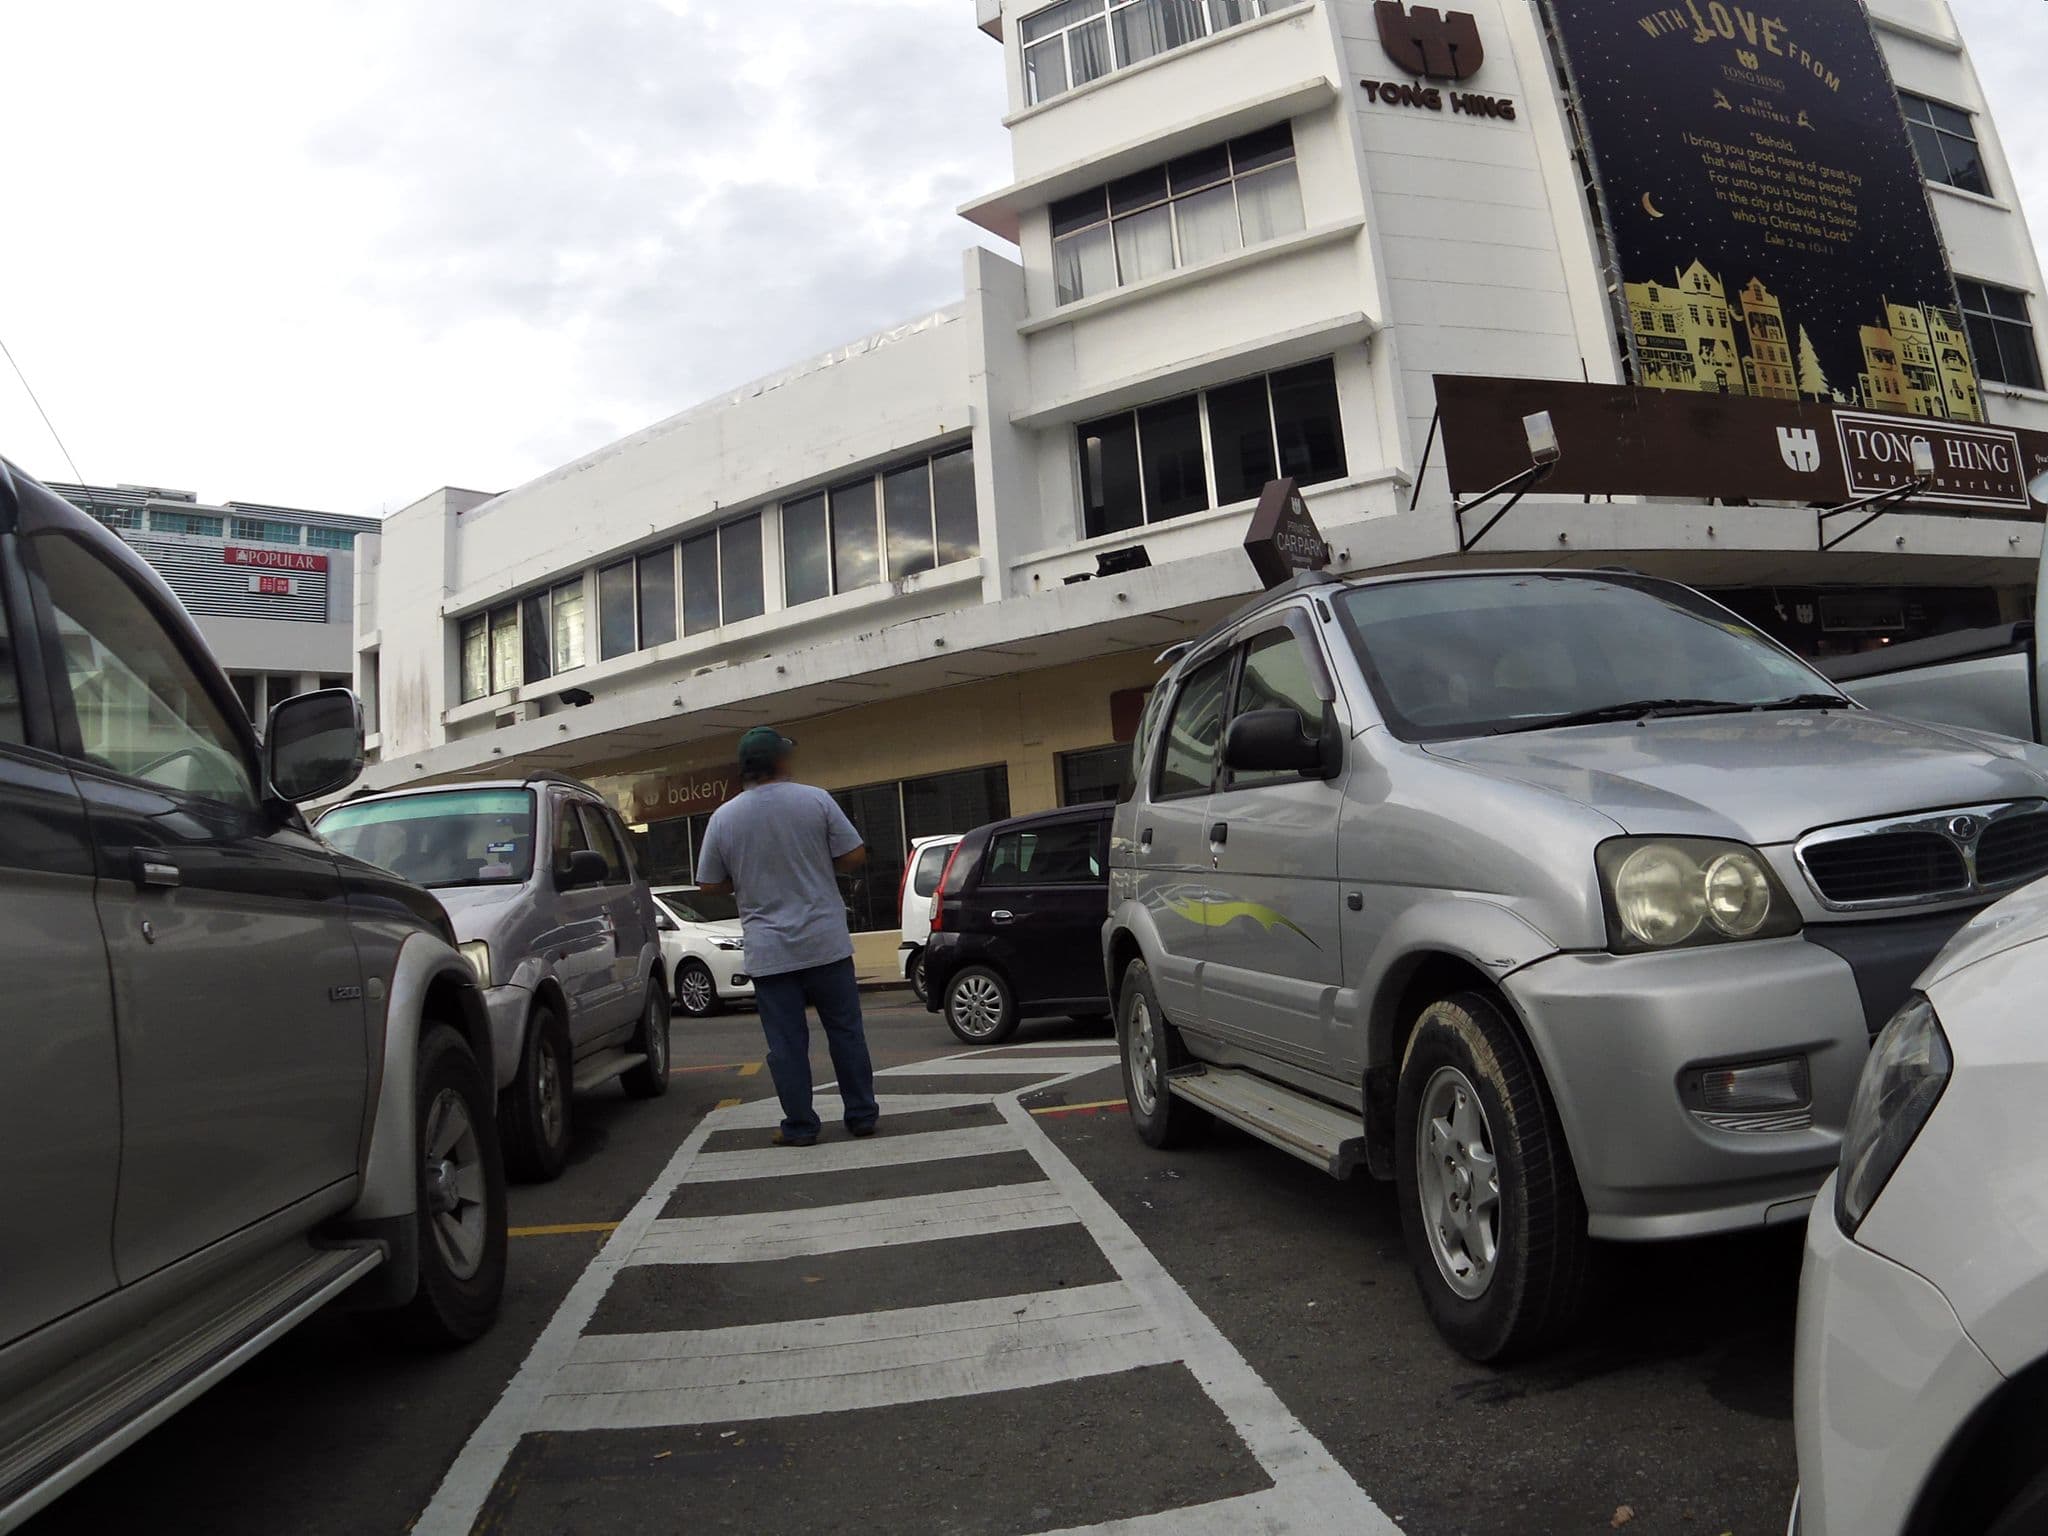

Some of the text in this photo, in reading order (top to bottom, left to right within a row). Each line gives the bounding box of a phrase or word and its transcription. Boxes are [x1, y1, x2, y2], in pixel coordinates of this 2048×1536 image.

[1637, 0, 1841, 93] WITH LOVE FROM
[1360, 80, 1516, 121] TONG HING
[1689, 132, 1721, 153] bring
[1723, 143, 1744, 156] you
[1746, 148, 1776, 163] good
[1778, 155, 1805, 170] news
[1806, 161, 1817, 173] of
[1819, 166, 1847, 181] great
[1847, 172, 1863, 187] joy
[1702, 152, 1726, 168] that
[1728, 158, 1748, 172] will
[1749, 163, 1765, 177] be
[1766, 165, 1782, 180] for
[1784, 170, 1797, 184] all
[1799, 174, 1816, 188] the
[1708, 169, 1729, 185] For
[1732, 177, 1758, 191] unto
[1759, 182, 1780, 196] you
[1782, 185, 1792, 198] is
[1819, 194, 1839, 209] this
[1839, 200, 1858, 216] day
[1714, 187, 1728, 201] in
[1728, 190, 1749, 206] the
[1751, 195, 1771, 213] city
[1773, 199, 1785, 213] of
[1785, 201, 1817, 221] David
[1731, 209, 1757, 225] who
[1758, 212, 1769, 226] is
[1769, 214, 1803, 233] Christ
[1804, 222, 1822, 237] the
[1848, 428, 2010, 474] TON HING
[248, 551, 316, 570] POPULAR
[667, 776, 729, 804] bakery
